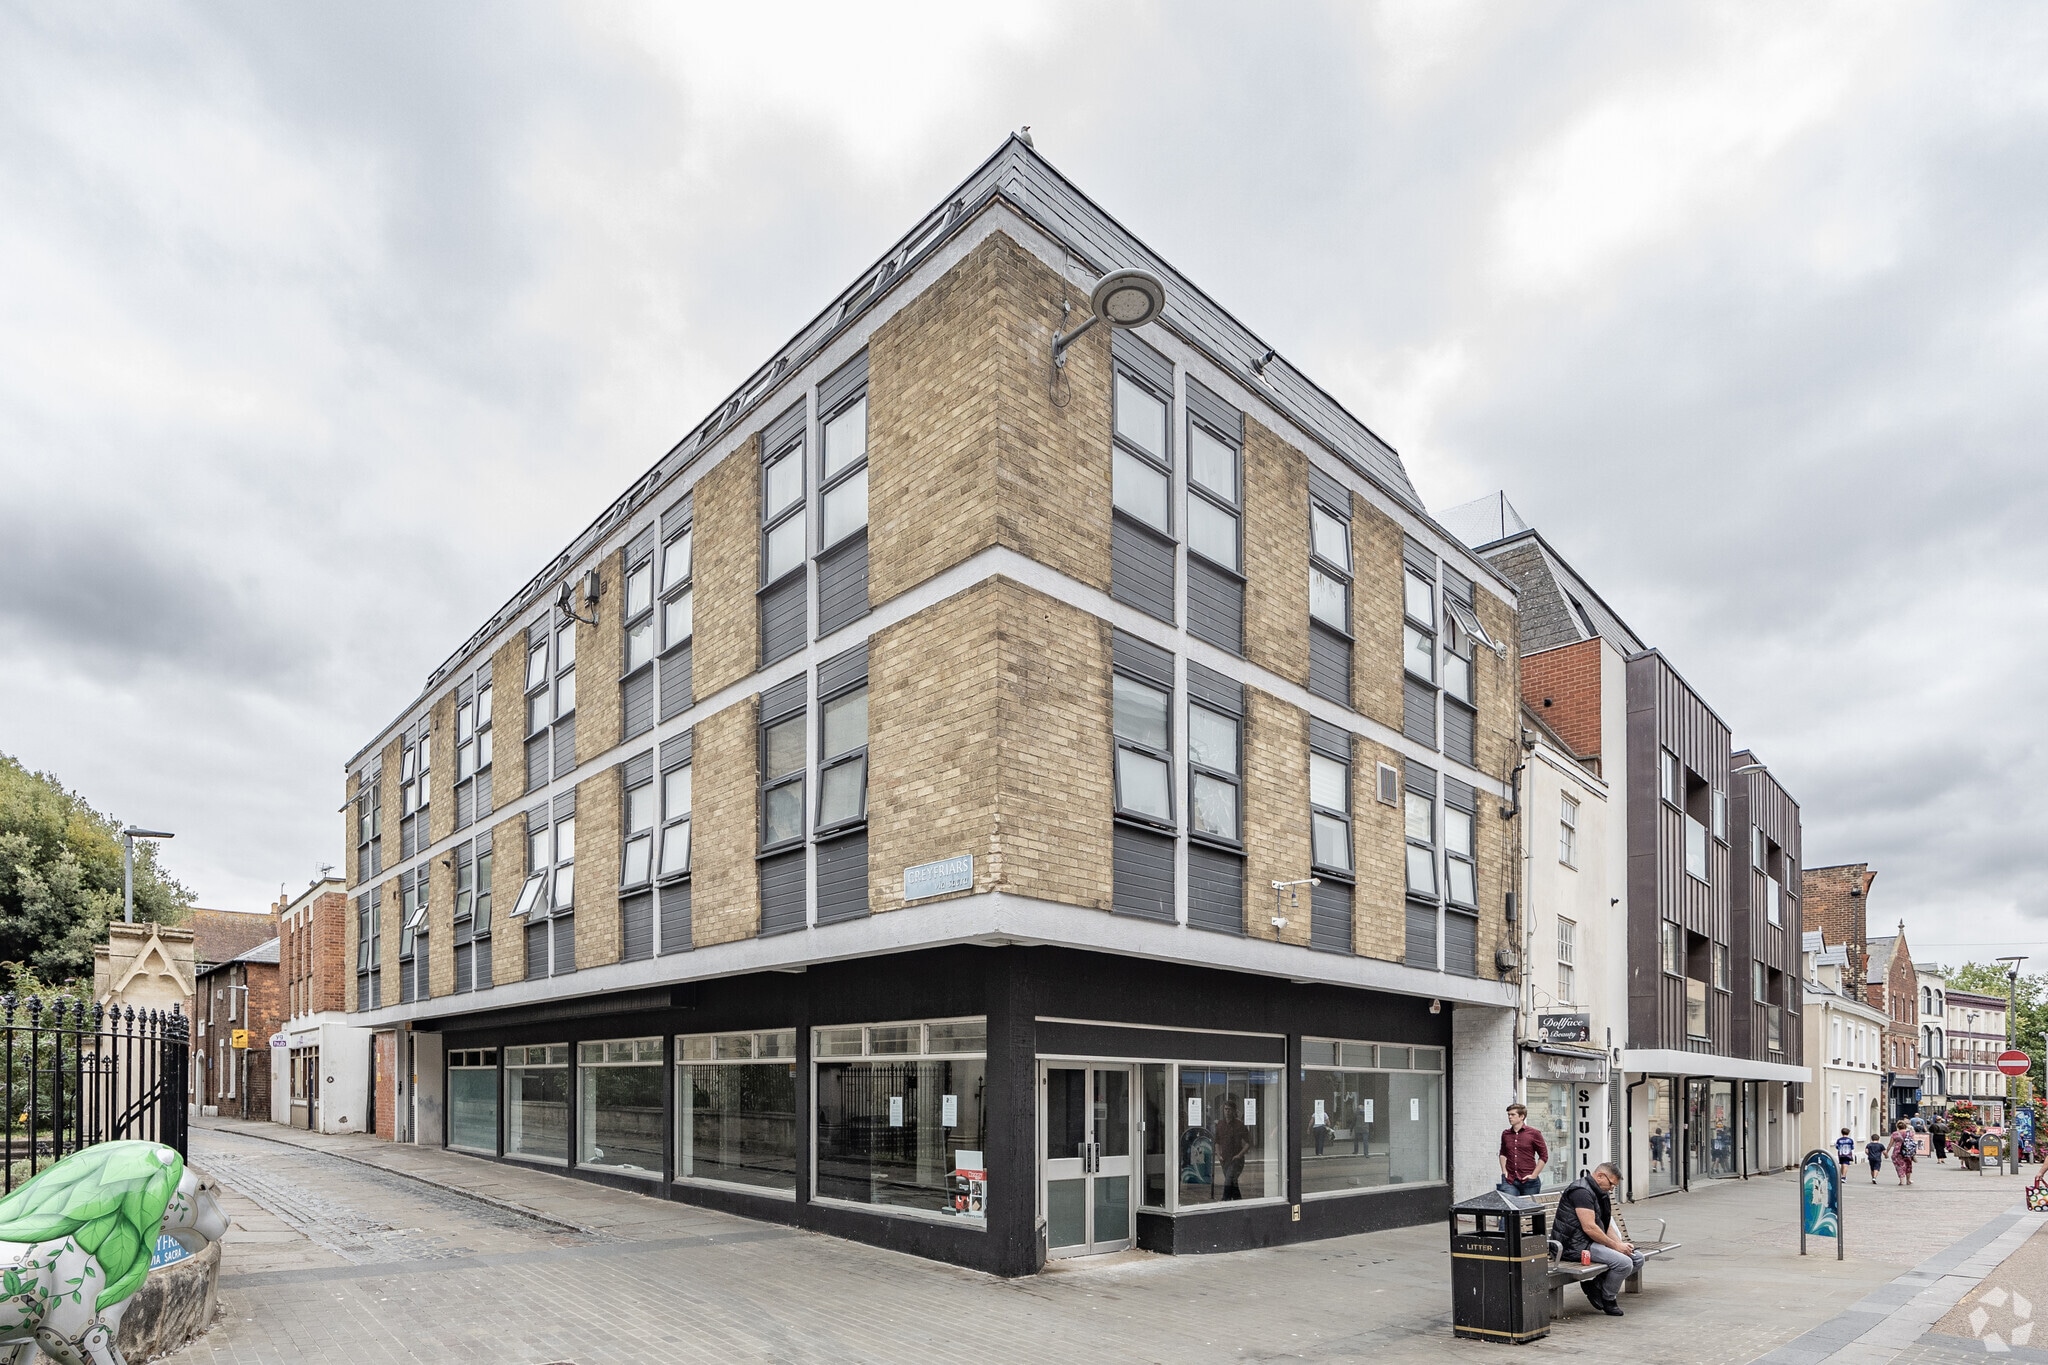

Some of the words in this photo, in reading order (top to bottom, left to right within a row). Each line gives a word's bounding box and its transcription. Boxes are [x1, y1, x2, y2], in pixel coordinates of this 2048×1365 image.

[907, 859, 969, 884] GREYFRIARS
[1543, 1017, 1584, 1030] Dollface
[1550, 1030, 1577, 1040] Beauty
[1548, 1057, 1569, 1079] Dollface
[1569, 1059, 1586, 1080] Beauty
[1578, 1089, 1591, 1179] STUDIO
[1466, 1243, 1493, 1252] LITTER
[164, 1248, 182, 1263] SACRA
